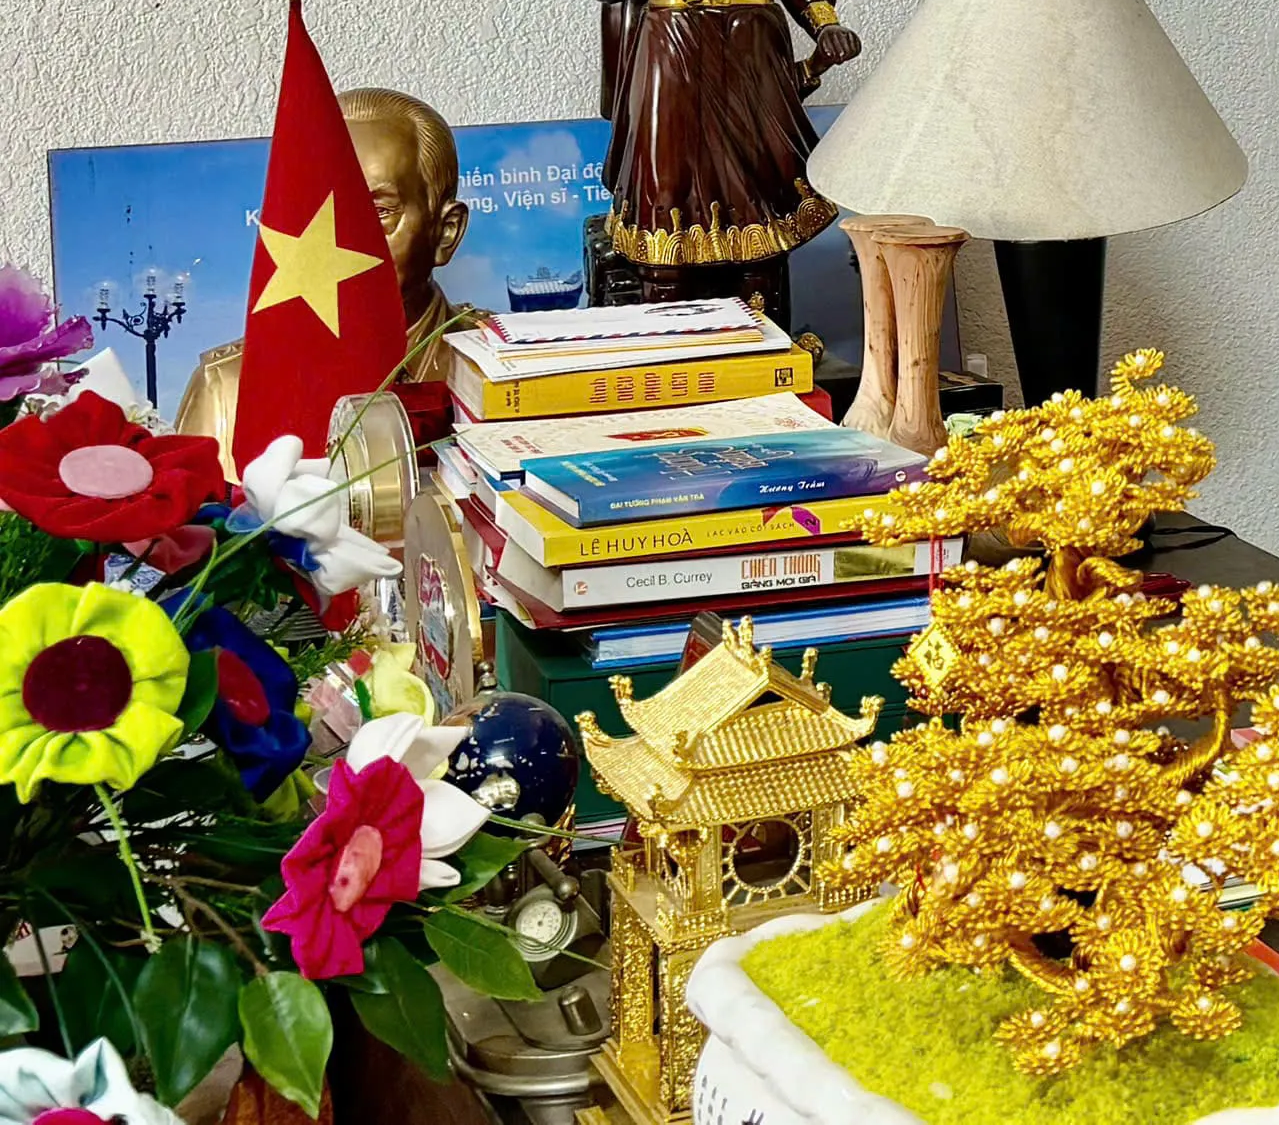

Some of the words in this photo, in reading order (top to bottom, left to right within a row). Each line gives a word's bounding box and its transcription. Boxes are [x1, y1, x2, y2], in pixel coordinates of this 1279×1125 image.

[459, 166, 495, 188] iến
[500, 167, 541, 185] binh
[547, 164, 577, 184] Đại
[503, 189, 545, 211] Viện
[551, 188, 568, 204] sĩ
[589, 377, 607, 404] Kinh
[580, 538, 601, 556] LÊ
[607, 536, 648, 553] HUY
[653, 527, 693, 549] HOÀ
[626, 575, 656, 588] Cecil
[673, 571, 713, 584] Currey
